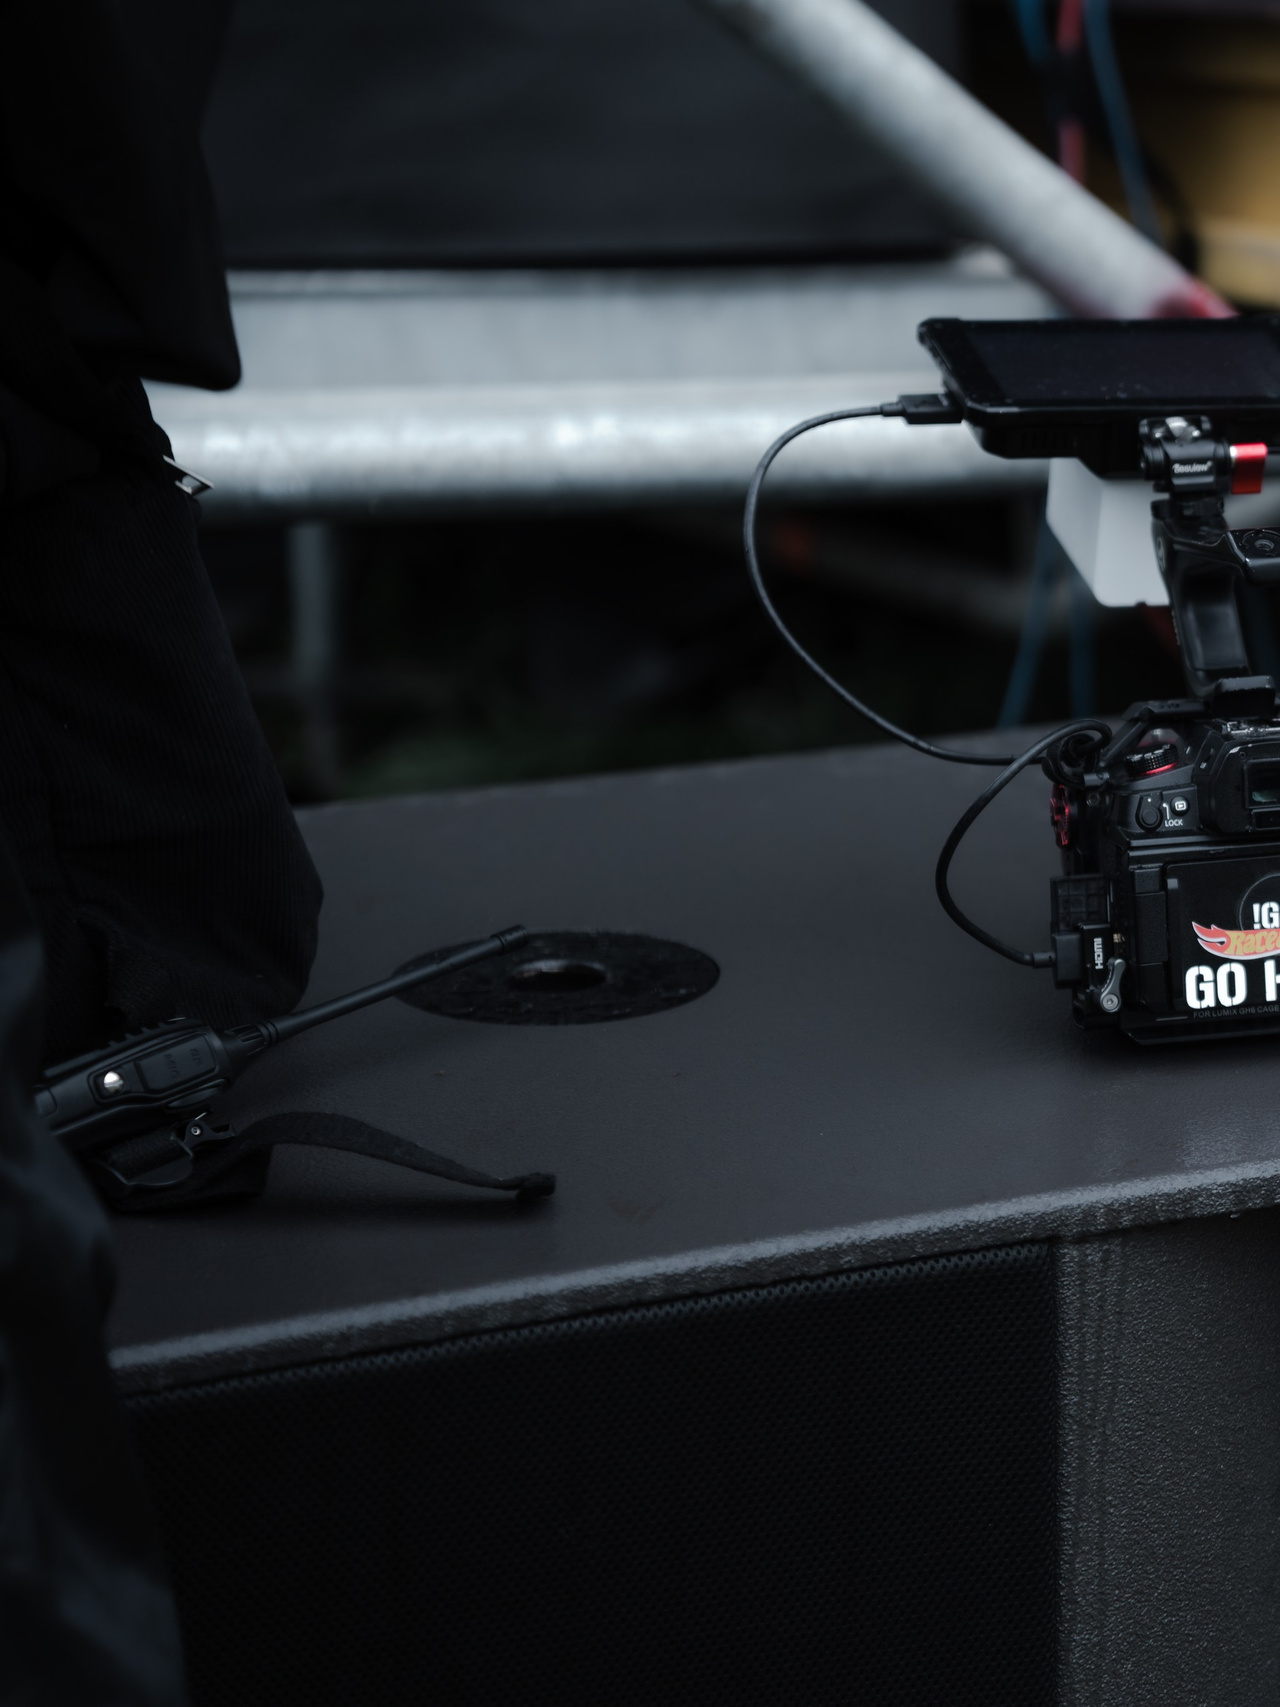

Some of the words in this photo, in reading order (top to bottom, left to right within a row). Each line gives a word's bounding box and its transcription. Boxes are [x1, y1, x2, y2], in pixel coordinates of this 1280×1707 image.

[1164, 818, 1184, 828] LOCK
[1093, 937, 1104, 970] HDMI
[1184, 961, 1248, 1010] GO
[1193, 1010, 1212, 1019] FOR
[1211, 1008, 1238, 1018] LUMIX
[1256, 1004, 1280, 1013] CAGE
